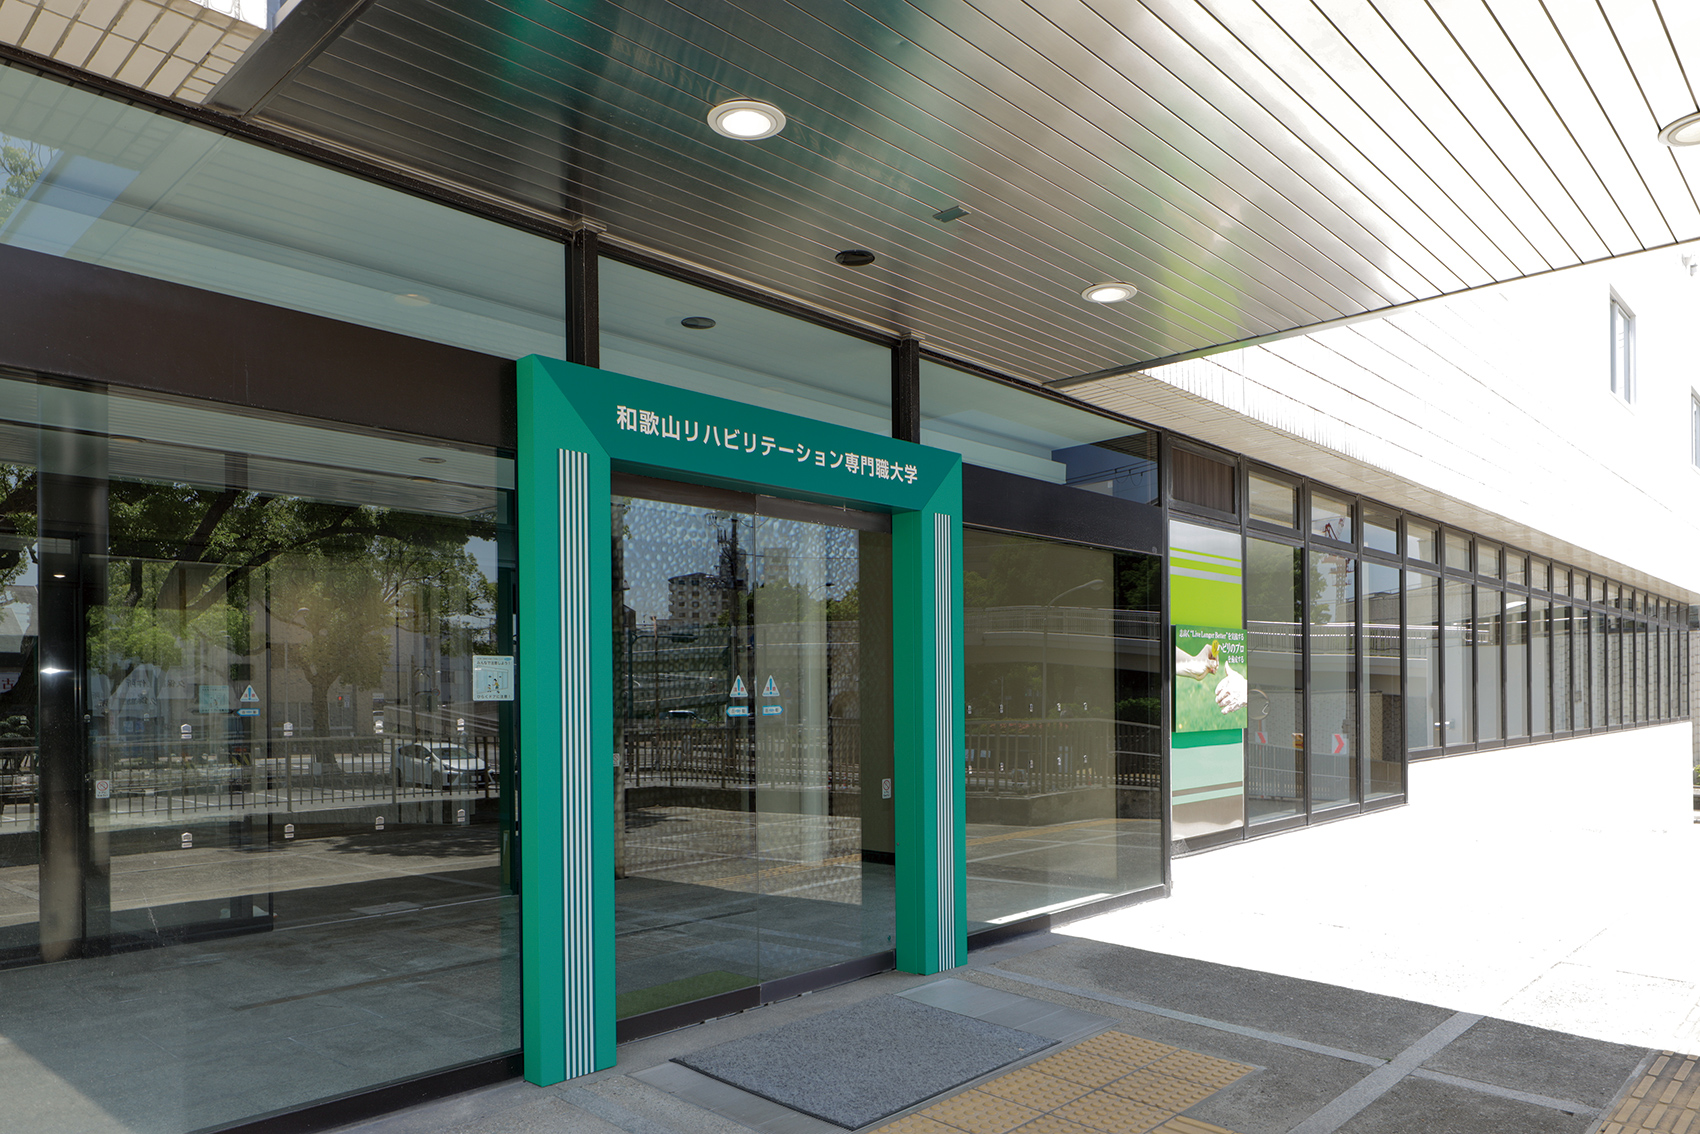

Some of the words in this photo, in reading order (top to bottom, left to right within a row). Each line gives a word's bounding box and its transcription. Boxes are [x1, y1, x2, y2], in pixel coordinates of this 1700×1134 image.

[616, 405, 918, 484] 和歌山リハビリテーション専門職大学
